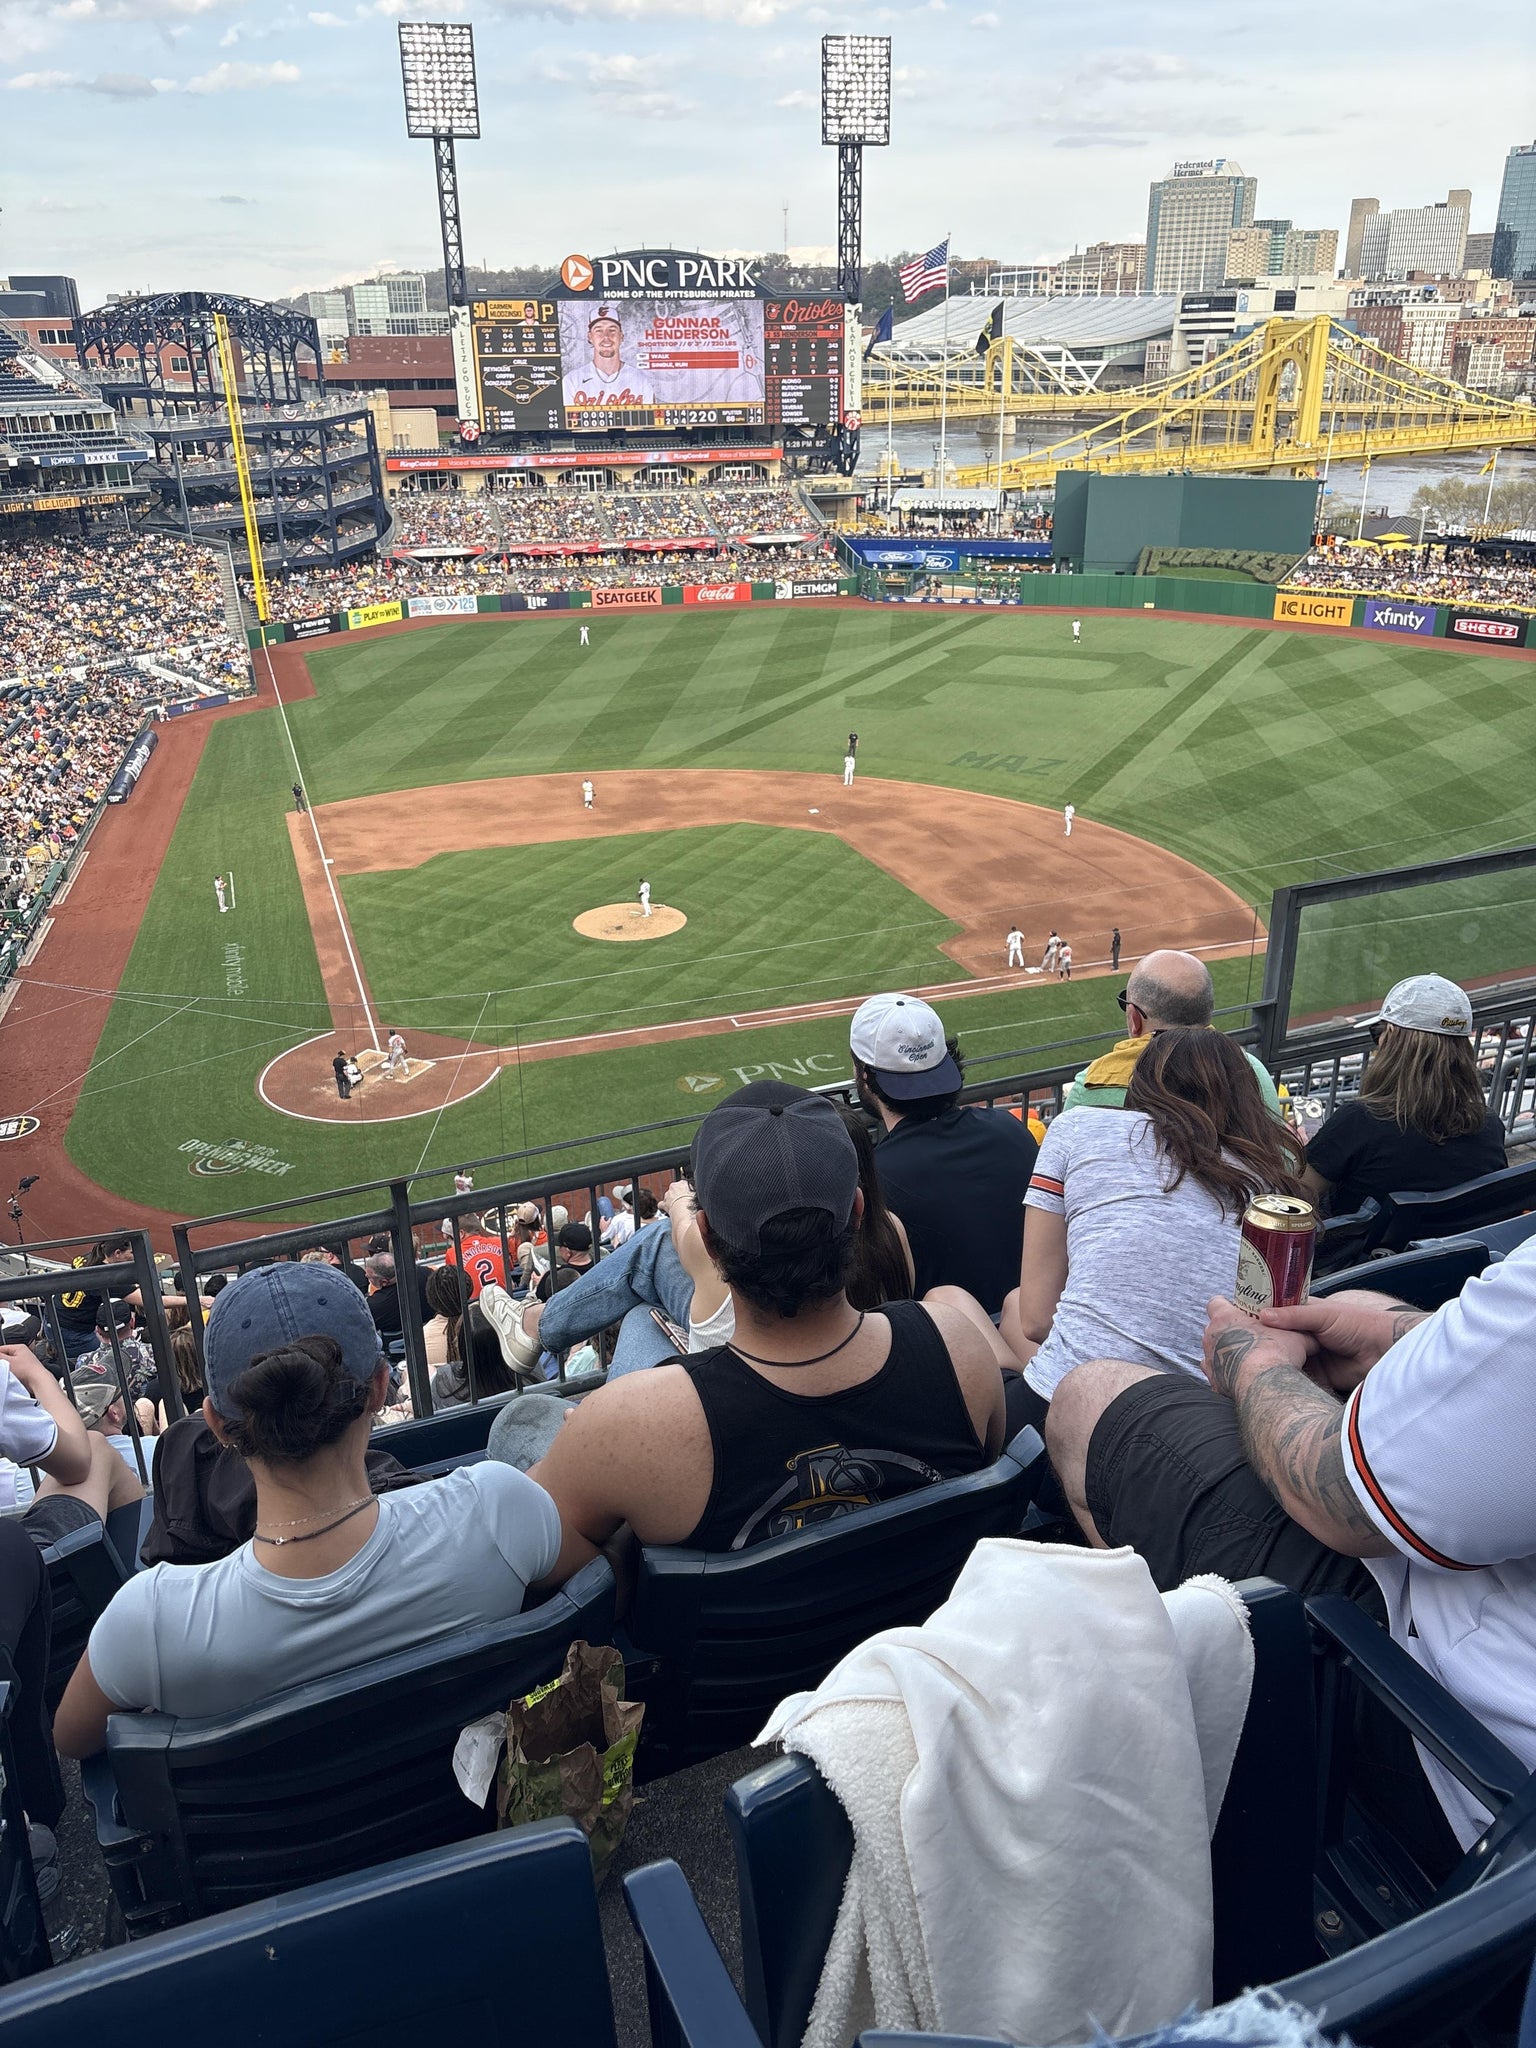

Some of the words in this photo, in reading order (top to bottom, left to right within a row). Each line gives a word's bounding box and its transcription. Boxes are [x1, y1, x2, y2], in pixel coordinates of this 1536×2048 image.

[1174, 160, 1213, 169] Federated
[598, 259, 669, 288] PNC
[675, 259, 757, 288] PARK
[604, 290, 630, 299] HOME
[631, 290, 644, 298] OF
[646, 290, 664, 298] THE
[664, 290, 718, 298] PITTSBURGH
[720, 290, 756, 298] PIRATES
[473, 302, 486, 318] 50
[783, 298, 845, 324] Orioles
[653, 317, 721, 328] GUNNAR
[644, 328, 730, 340] HENDERSON
[462, 367, 470, 382] GO
[464, 386, 472, 417] BUCS
[688, 410, 718, 424] 220
[50, 456, 76, 466] KOPPERS
[400, 460, 439, 468] RingCentral
[538, 456, 577, 464] RingCentral
[672, 452, 710, 460] RingCentral
[3, 502, 25, 513] LIGHT
[52, 498, 74, 508] LIGHT
[98, 494, 118, 504] LIGHT
[914, 500, 935, 510] FAT
[938, 500, 983, 510] HEAD'S
[1135, 544, 1302, 585] PIRATES
[794, 582, 838, 595] BETMGM
[460, 597, 475, 610] 125
[524, 596, 548, 610] Lite
[596, 590, 658, 606] SEATGEEK
[364, 610, 379, 622] PLAY
[386, 607, 400, 618] WIN!
[1281, 600, 1298, 616] IC
[1301, 603, 1346, 619] LIGHT
[1373, 606, 1426, 631] xfinity
[1458, 622, 1514, 637] SHEETZ
[182, 703, 200, 712] FedEx
[943, 750, 1069, 776] MAZ
[220, 942, 246, 966] xfinity
[226, 967, 248, 996] mobile
[898, 1038, 935, 1054] Cincinnati
[908, 1052, 928, 1063] Open
[728, 1054, 846, 1085] PNC
[177, 1138, 252, 1165] OPENING
[243, 1153, 297, 1177] WEEK
[476, 1258, 498, 1288] 2
